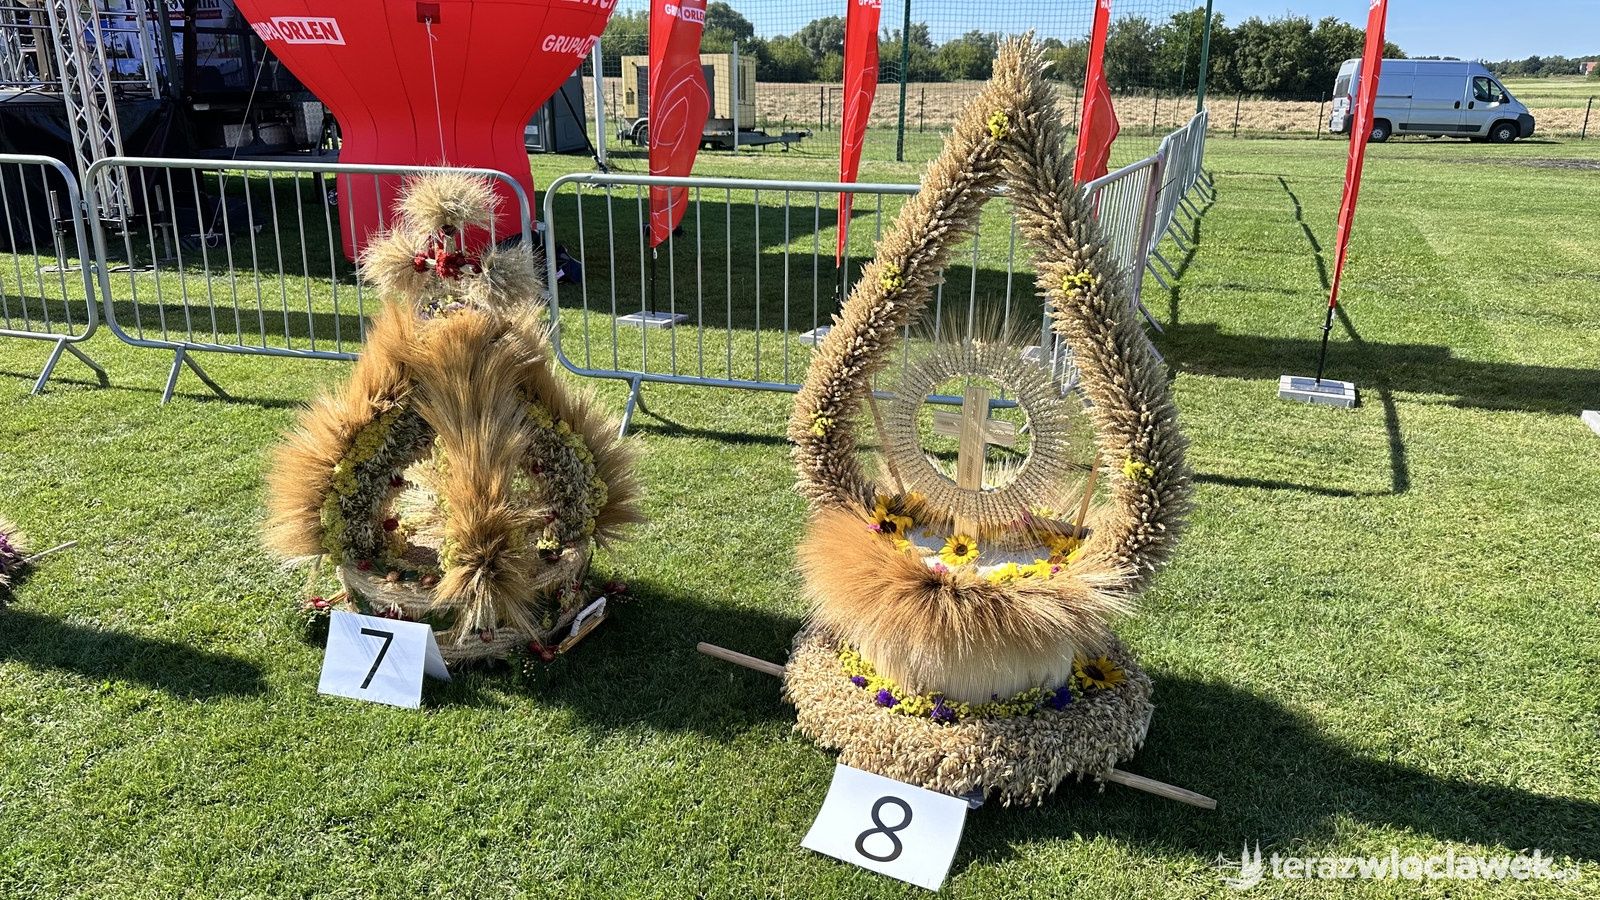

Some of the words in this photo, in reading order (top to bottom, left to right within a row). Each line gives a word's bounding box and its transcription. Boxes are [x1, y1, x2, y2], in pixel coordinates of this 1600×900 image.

[278, 21, 339, 41] ORLEN
[541, 34, 587, 54] GRUPA
[360, 627, 394, 690] 7
[854, 795, 913, 863] 8
